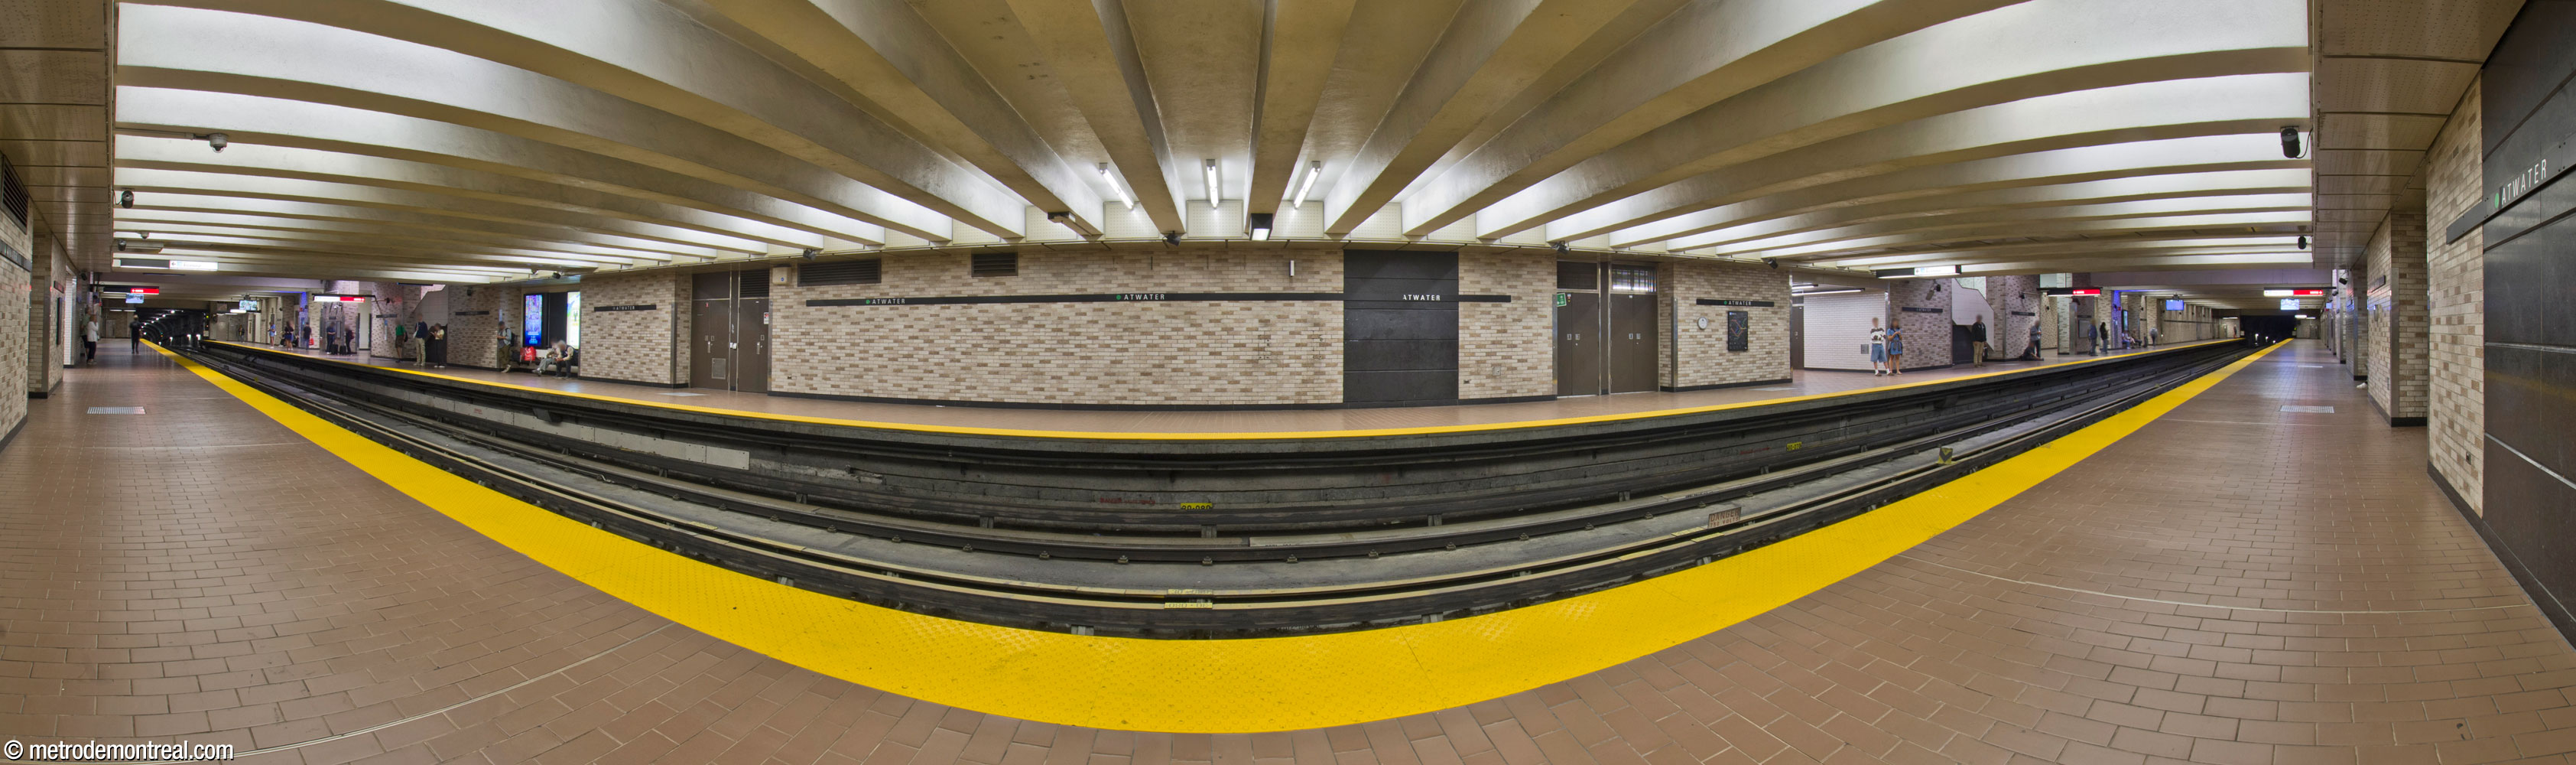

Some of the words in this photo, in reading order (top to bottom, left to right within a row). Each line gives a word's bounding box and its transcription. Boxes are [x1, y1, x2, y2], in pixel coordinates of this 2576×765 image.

[2501, 158, 2547, 206] ATWATER
[1710, 508, 1740, 522] DANGER
[1723, 516, 1739, 525] VOLTS
